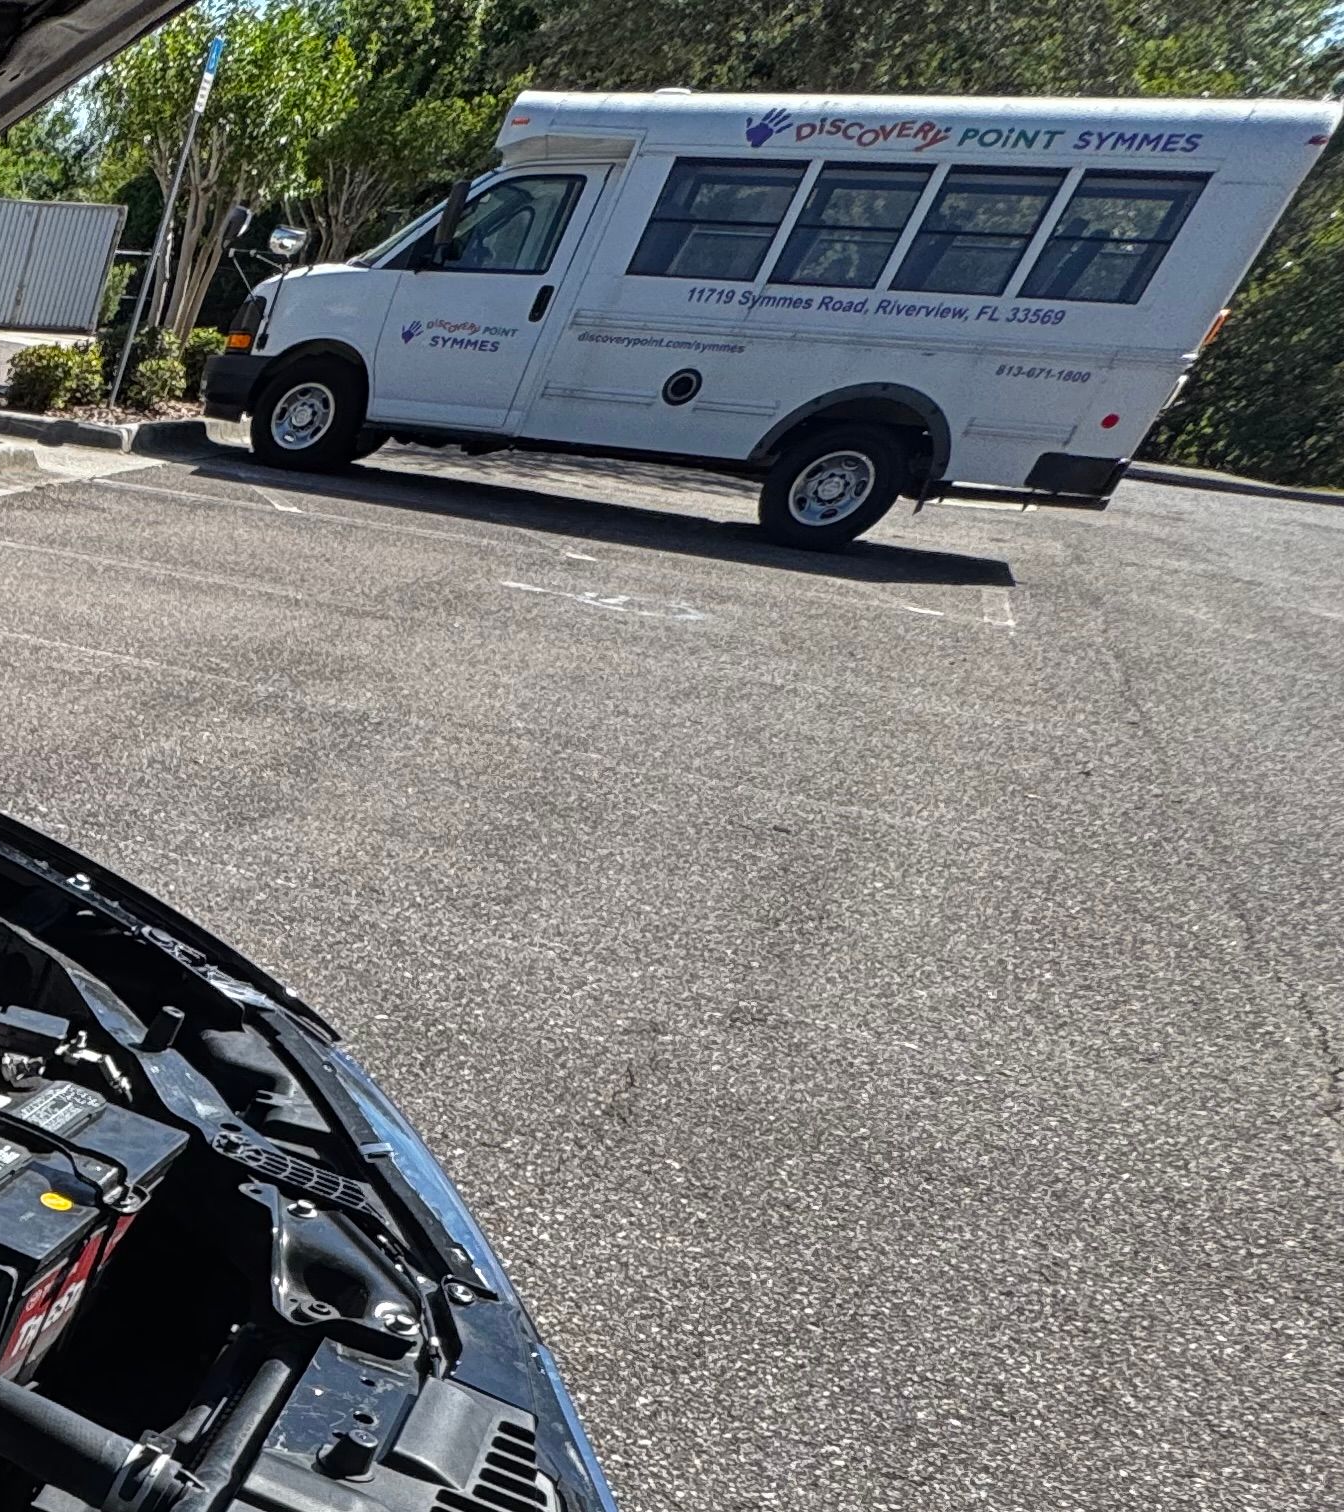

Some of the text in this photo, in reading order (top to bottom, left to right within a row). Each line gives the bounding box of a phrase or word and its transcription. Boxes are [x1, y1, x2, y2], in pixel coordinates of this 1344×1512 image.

[1073, 130, 1204, 152] SYMMES
[687, 287, 1067, 325] 11719 Symmes Road, Riverview, FL 33569
[429, 335, 501, 353] SYMMES
[577, 331, 746, 354] discoverypoint.com/symmes
